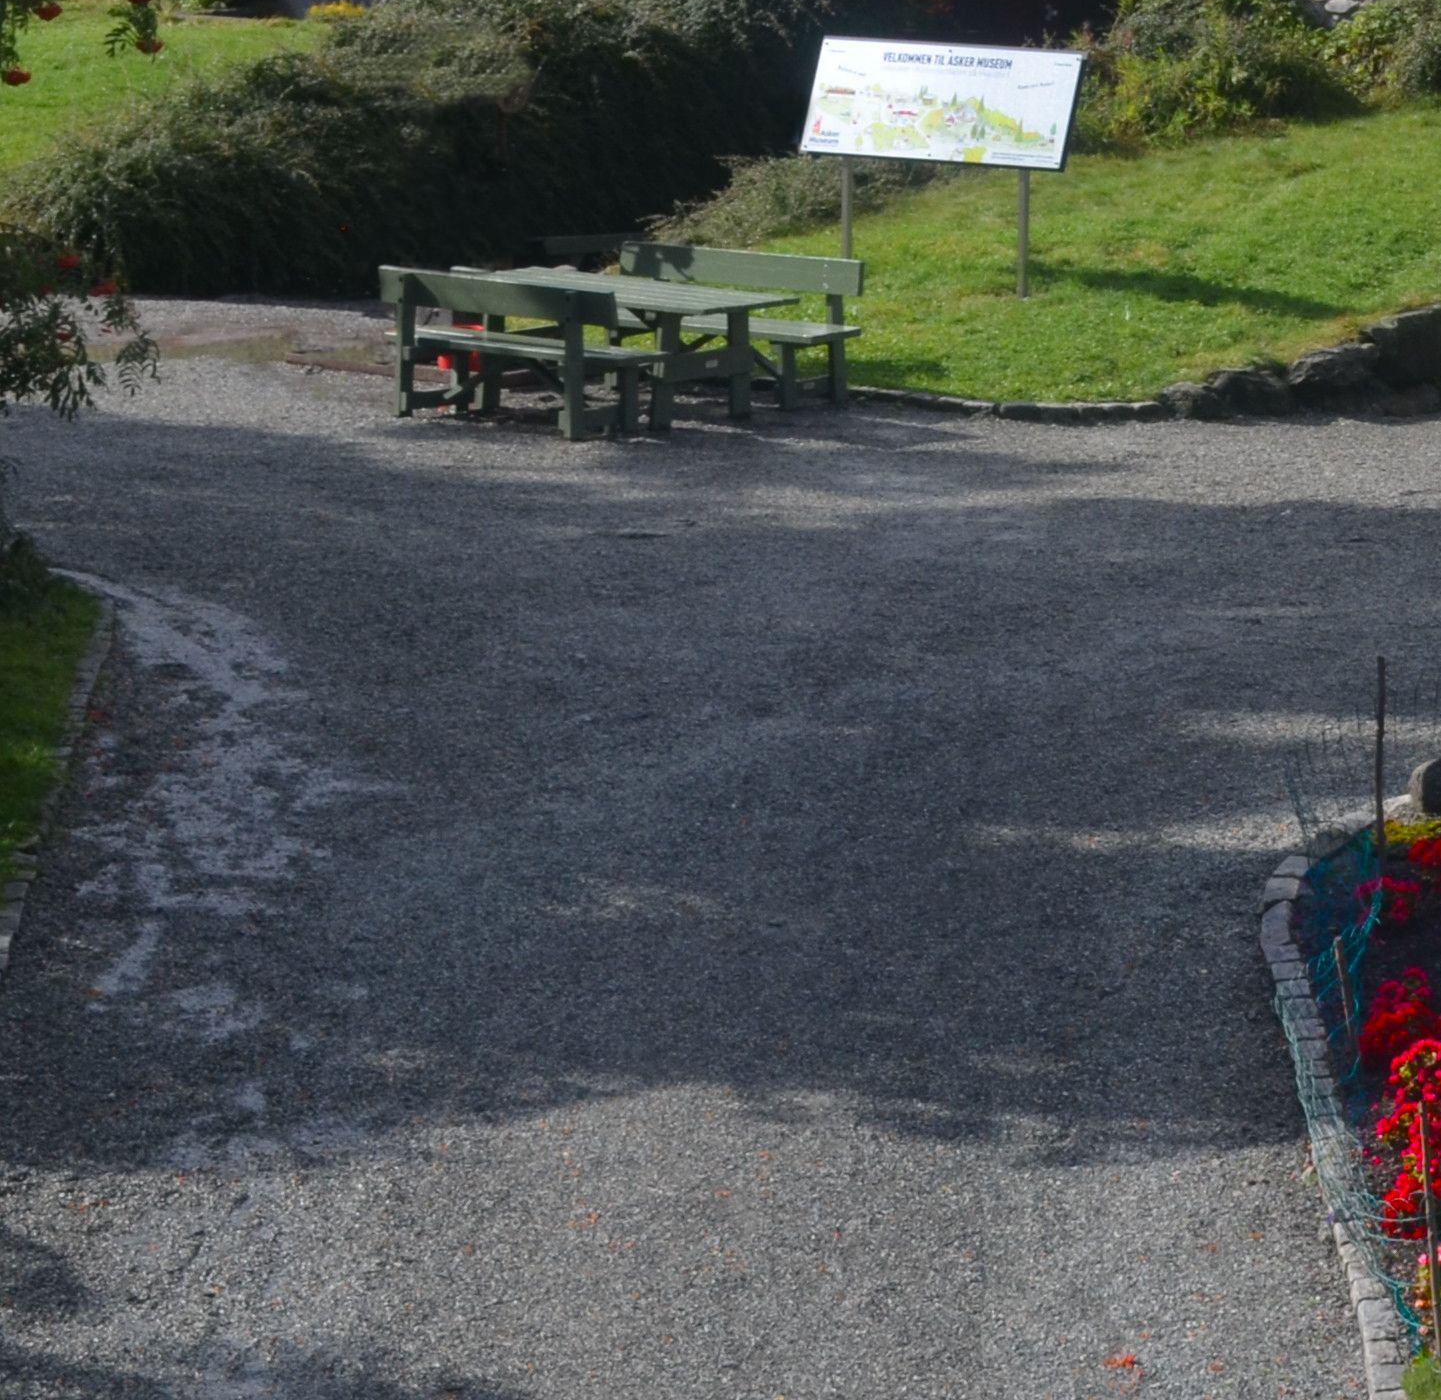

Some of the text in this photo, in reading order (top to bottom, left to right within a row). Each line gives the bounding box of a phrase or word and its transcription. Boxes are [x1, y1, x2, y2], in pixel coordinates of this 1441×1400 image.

[883, 52, 932, 65] VELKOMMEN
[934, 54, 945, 66] TIL
[947, 55, 975, 68] ASKER
[976, 57, 1013, 70] MUSEUM
